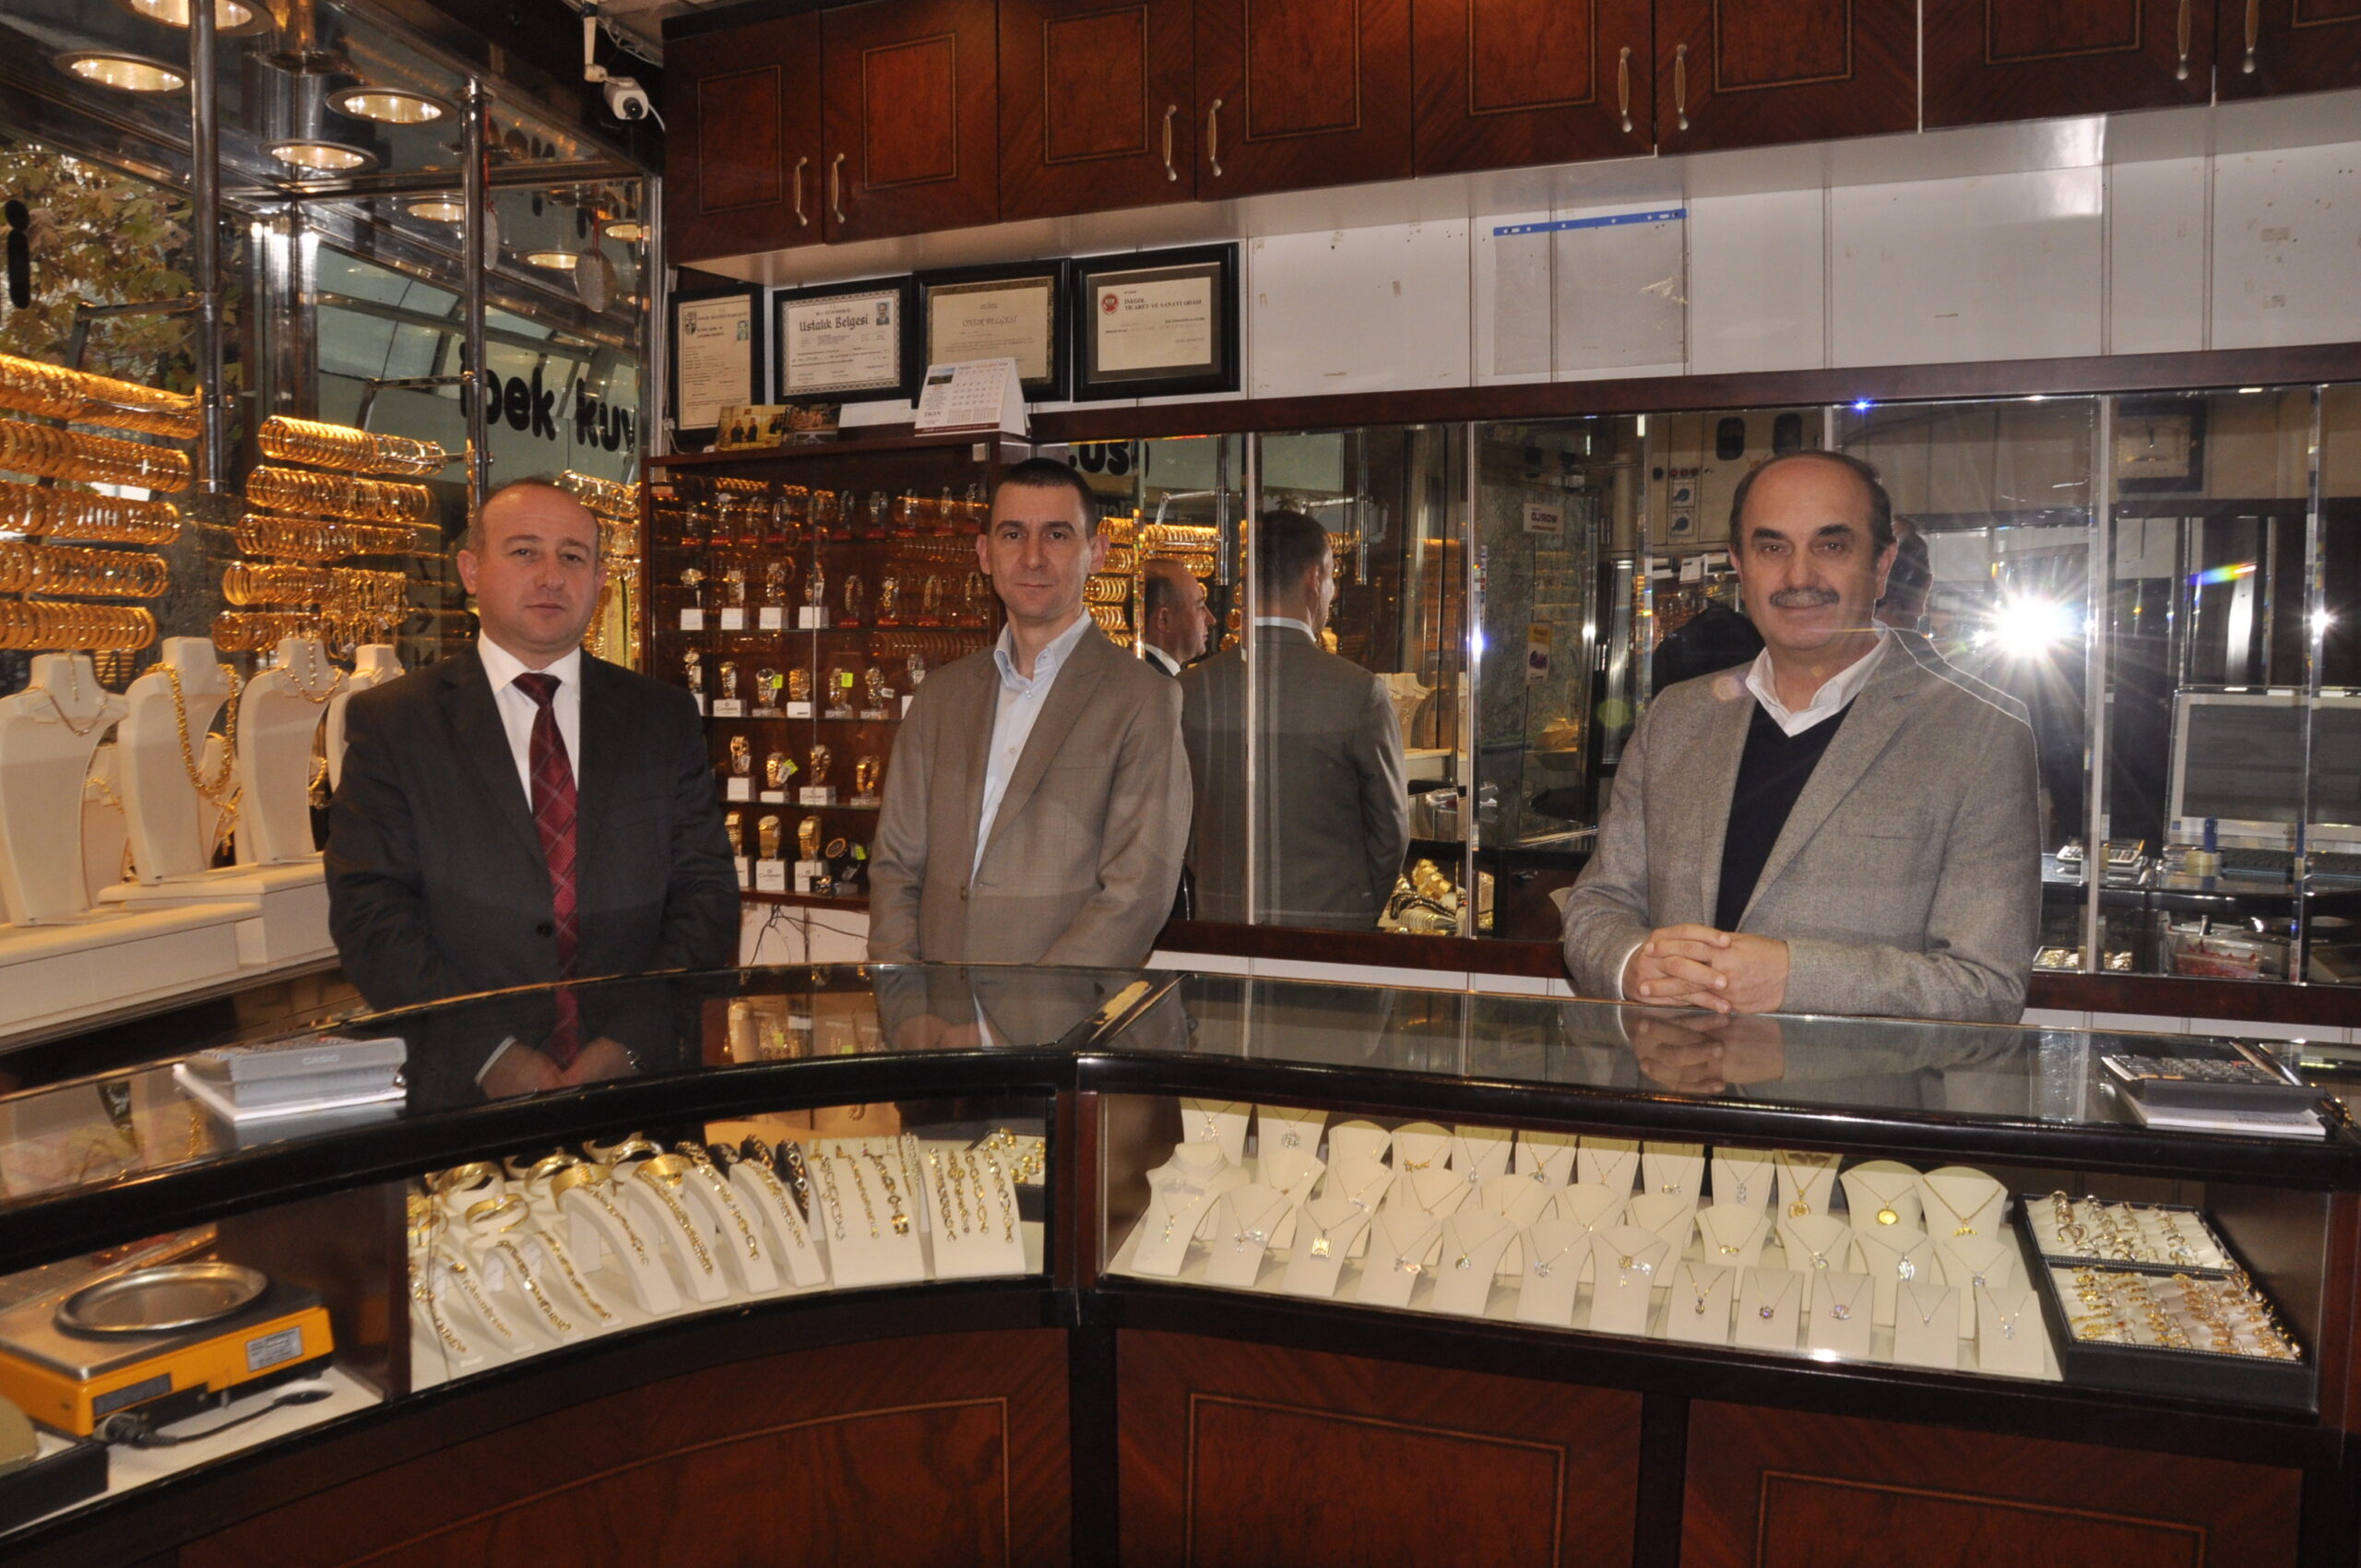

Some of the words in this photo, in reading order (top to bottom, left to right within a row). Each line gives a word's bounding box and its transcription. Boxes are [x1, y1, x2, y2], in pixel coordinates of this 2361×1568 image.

[800, 318, 832, 332] Ustalık
[836, 313, 869, 331] Belgesi
[302, 1054, 340, 1065] CASIO
